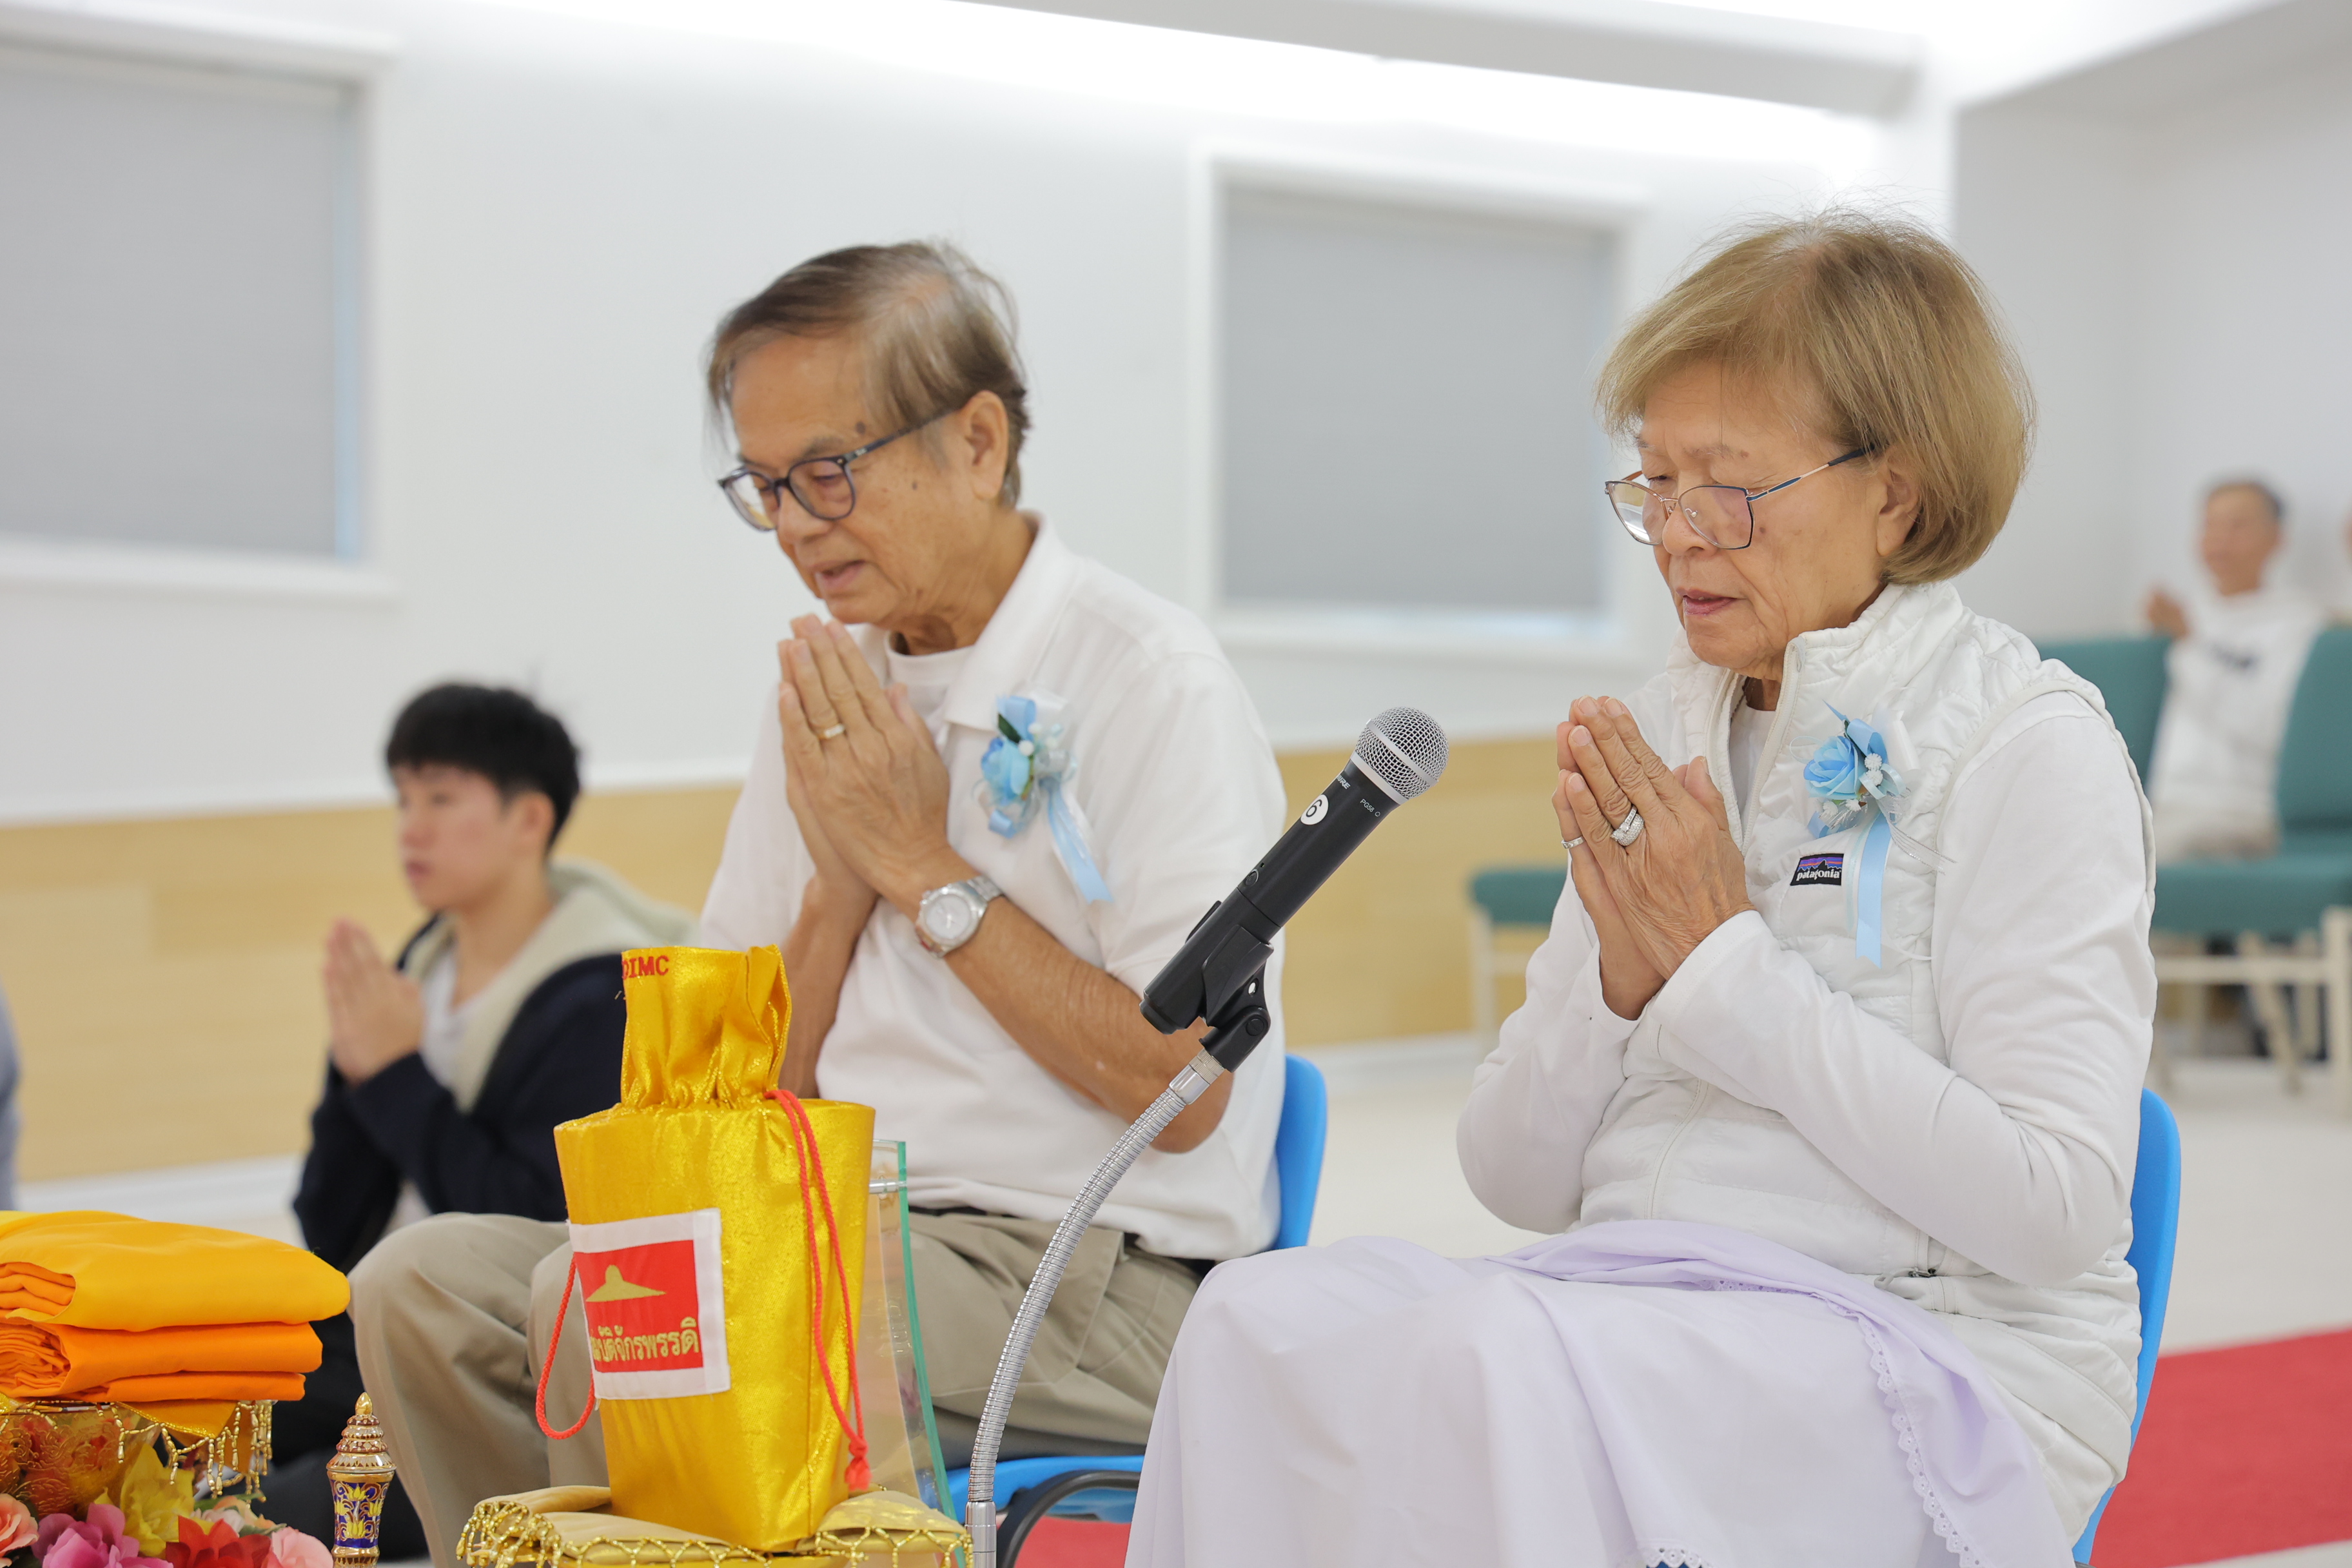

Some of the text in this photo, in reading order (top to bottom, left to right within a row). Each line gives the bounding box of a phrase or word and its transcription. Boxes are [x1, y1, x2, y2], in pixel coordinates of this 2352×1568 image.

[1337, 774, 1351, 790] URE
[1306, 799, 1322, 818] 6
[1360, 799, 1375, 813] PG58
[1796, 869, 1841, 881] patagonia
